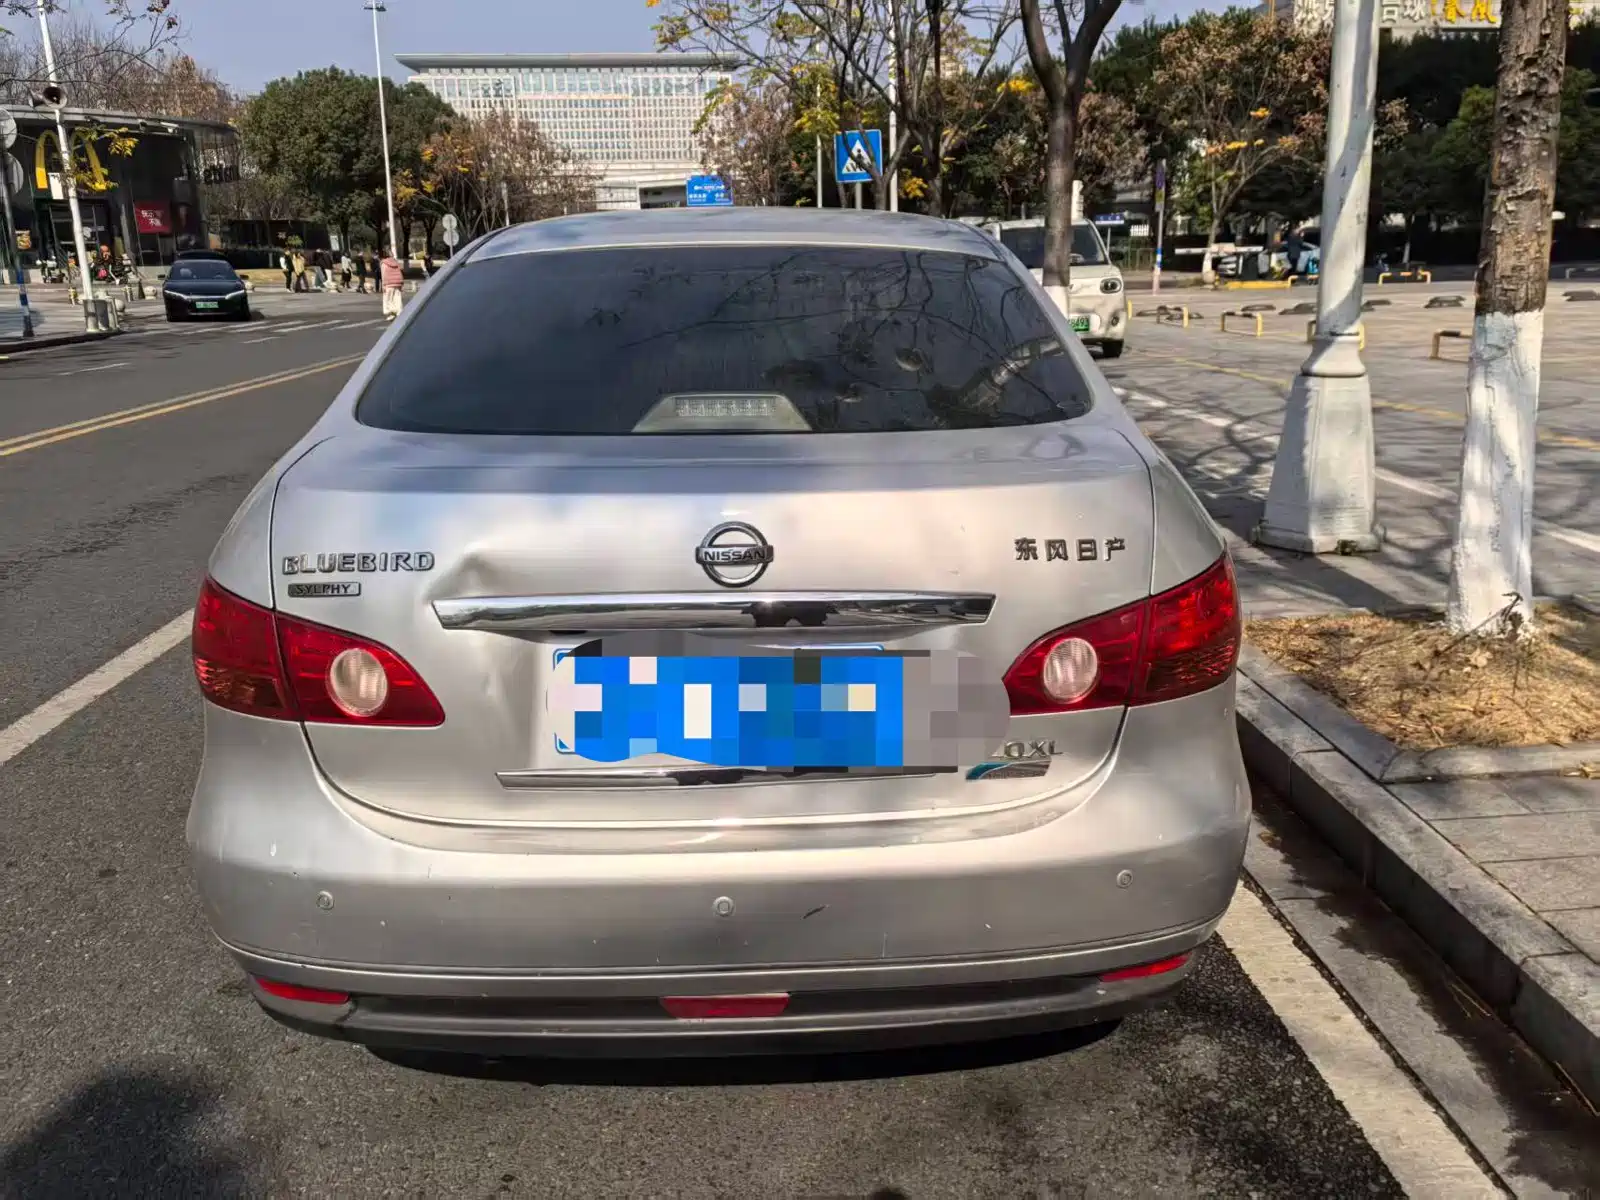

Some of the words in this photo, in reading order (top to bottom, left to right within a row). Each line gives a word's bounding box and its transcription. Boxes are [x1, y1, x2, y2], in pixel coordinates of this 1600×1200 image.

[703, 549, 766, 562] NISSAN
[1014, 537, 1125, 562] 东风日产
[282, 551, 435, 575] BLUEBIRD
[296, 583, 351, 595] SYLPHY
